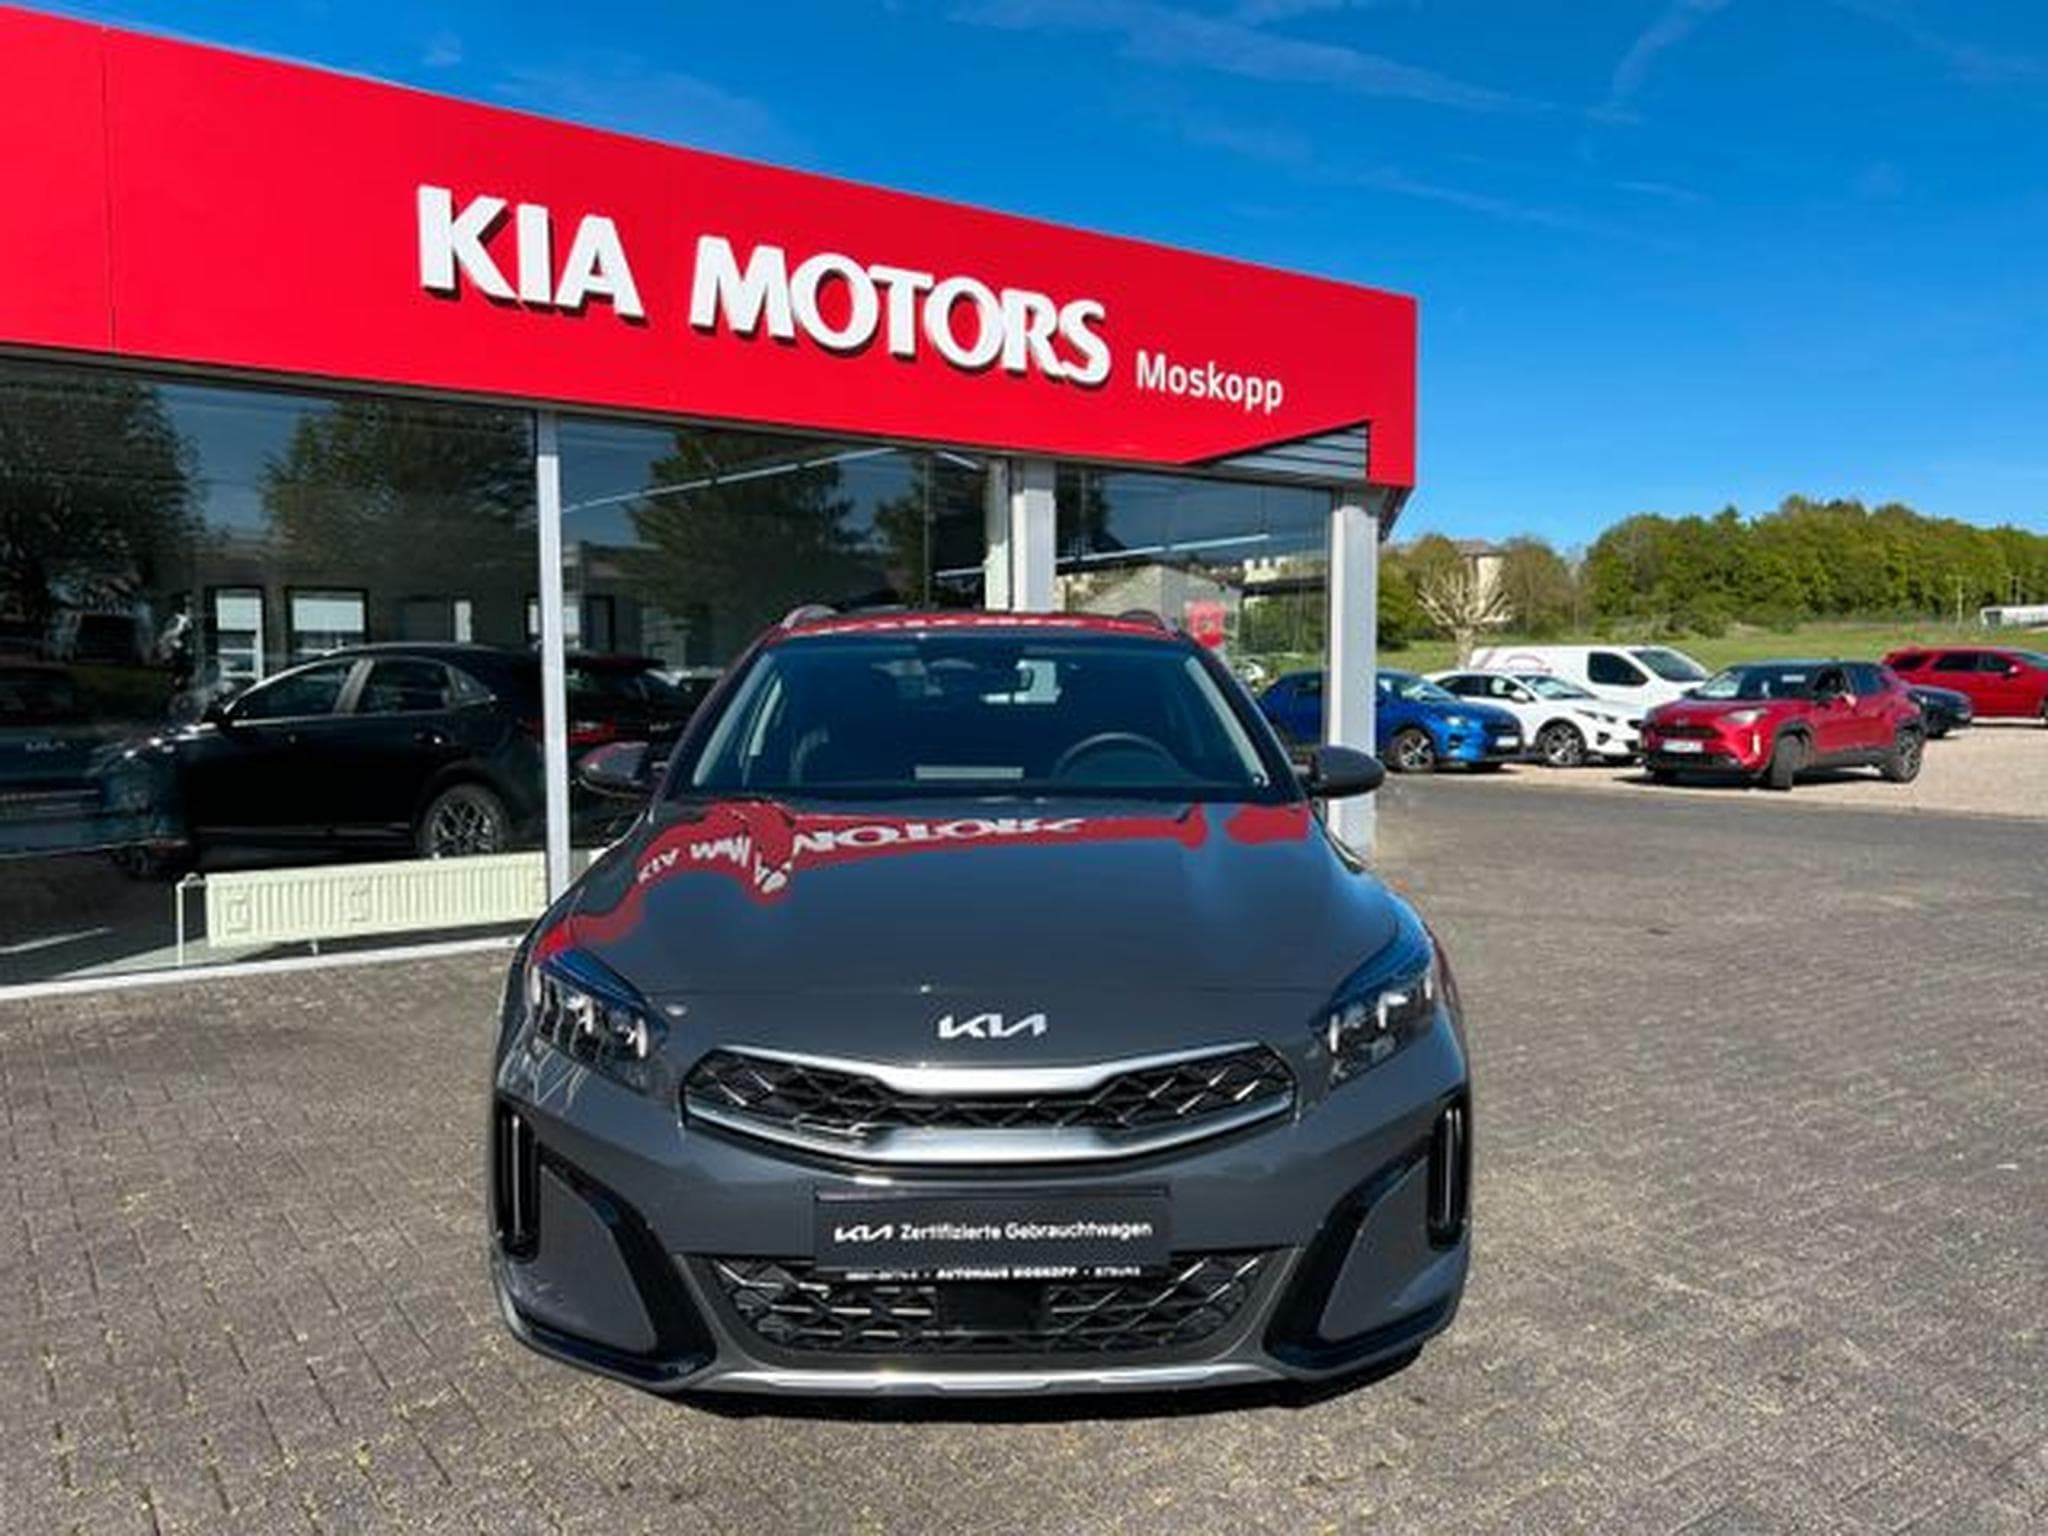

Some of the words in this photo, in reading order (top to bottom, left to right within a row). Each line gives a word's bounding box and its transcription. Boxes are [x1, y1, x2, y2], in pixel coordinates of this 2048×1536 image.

[417, 184, 646, 318] KIA
[689, 235, 1111, 384] MOTORS
[1136, 349, 1284, 415] Moskopp
[938, 1013, 1046, 1038] KIA
[834, 1223, 894, 1242] KIA
[901, 1223, 1001, 1240] Zertifizierte
[1004, 1221, 1153, 1240] Gebrauchtwagen
